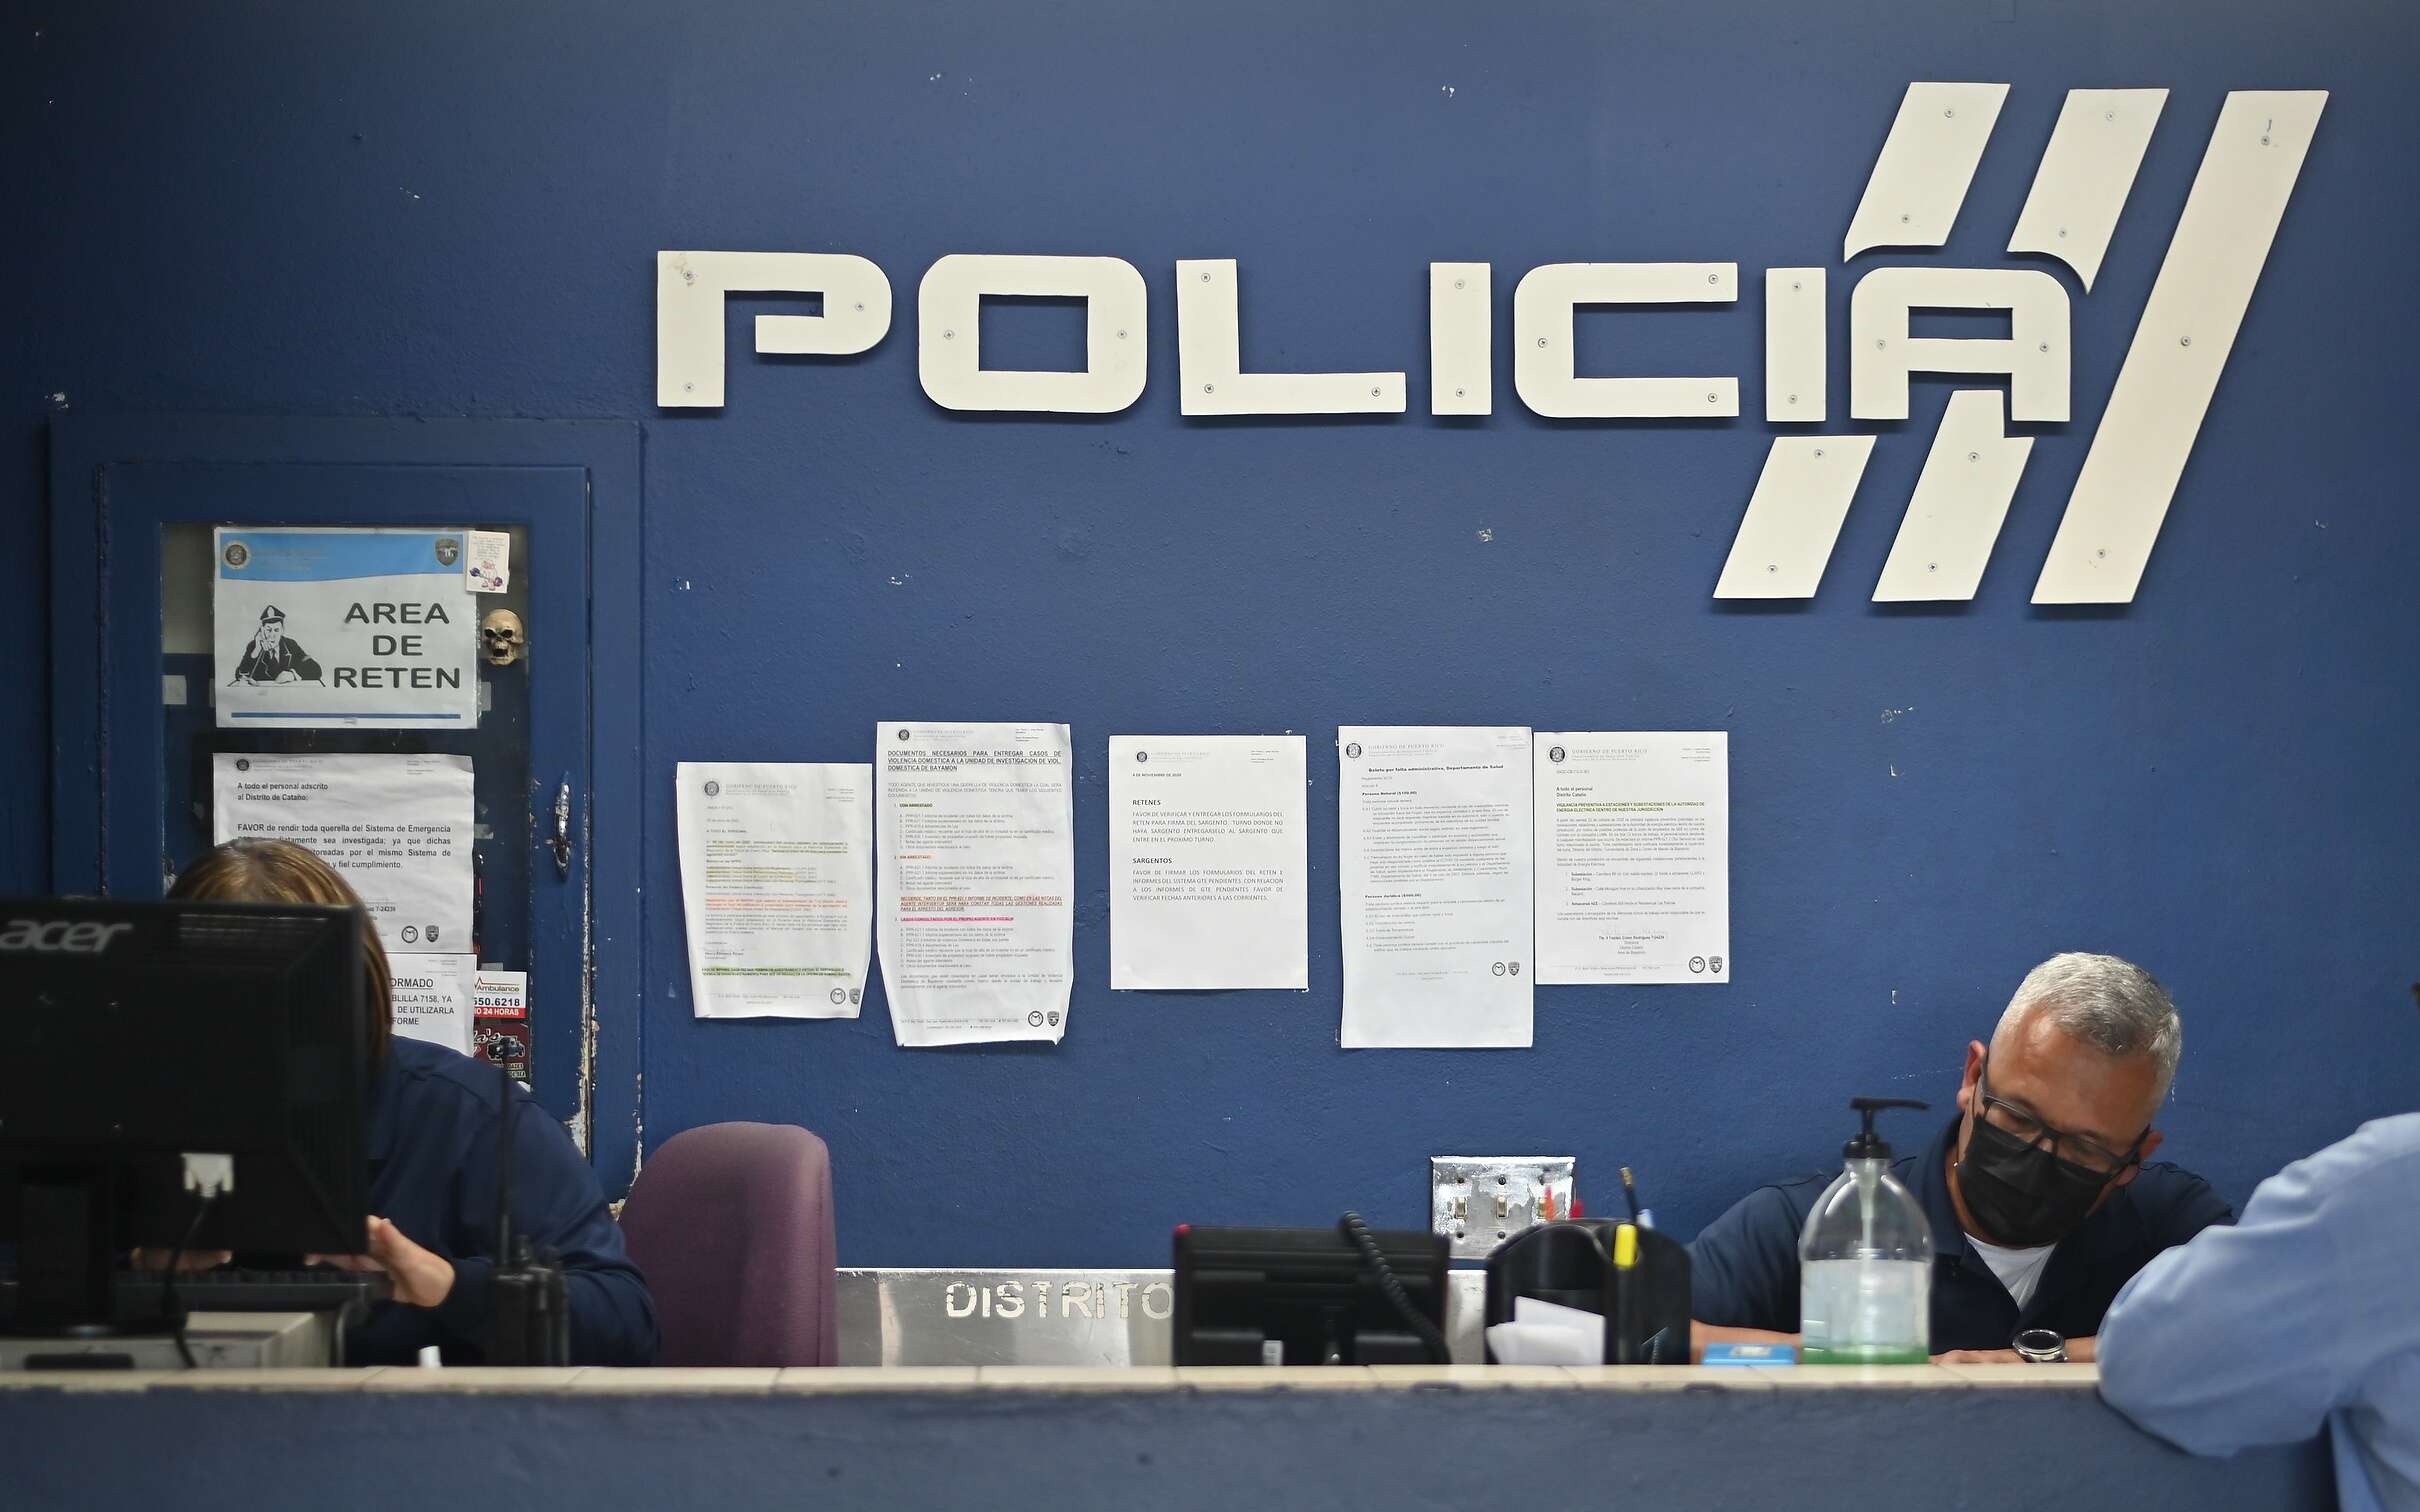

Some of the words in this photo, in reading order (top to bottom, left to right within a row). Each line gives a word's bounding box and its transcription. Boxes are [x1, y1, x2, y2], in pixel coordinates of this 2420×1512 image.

[656, 250, 2071, 423] POLICIA
[345, 602, 450, 625] AREA
[373, 635, 422, 657] DE
[334, 667, 460, 689] RETEN
[270, 782, 299, 791] personal
[321, 824, 350, 834] querella
[408, 825, 450, 834] Emergencia
[350, 850, 362, 858] por
[0, 919, 134, 952] acer
[391, 978, 433, 988] ORMADO
[392, 994, 418, 1003] BLILLA
[441, 994, 452, 1003] YA
[398, 1006, 408, 1014] DE
[410, 1006, 454, 1014] UTILIZARLA
[483, 1008, 493, 1016] 24
[495, 1008, 519, 1016] HORAS
[392, 1017, 419, 1025] FORME
[946, 1280, 1174, 1319] DISTRITO
